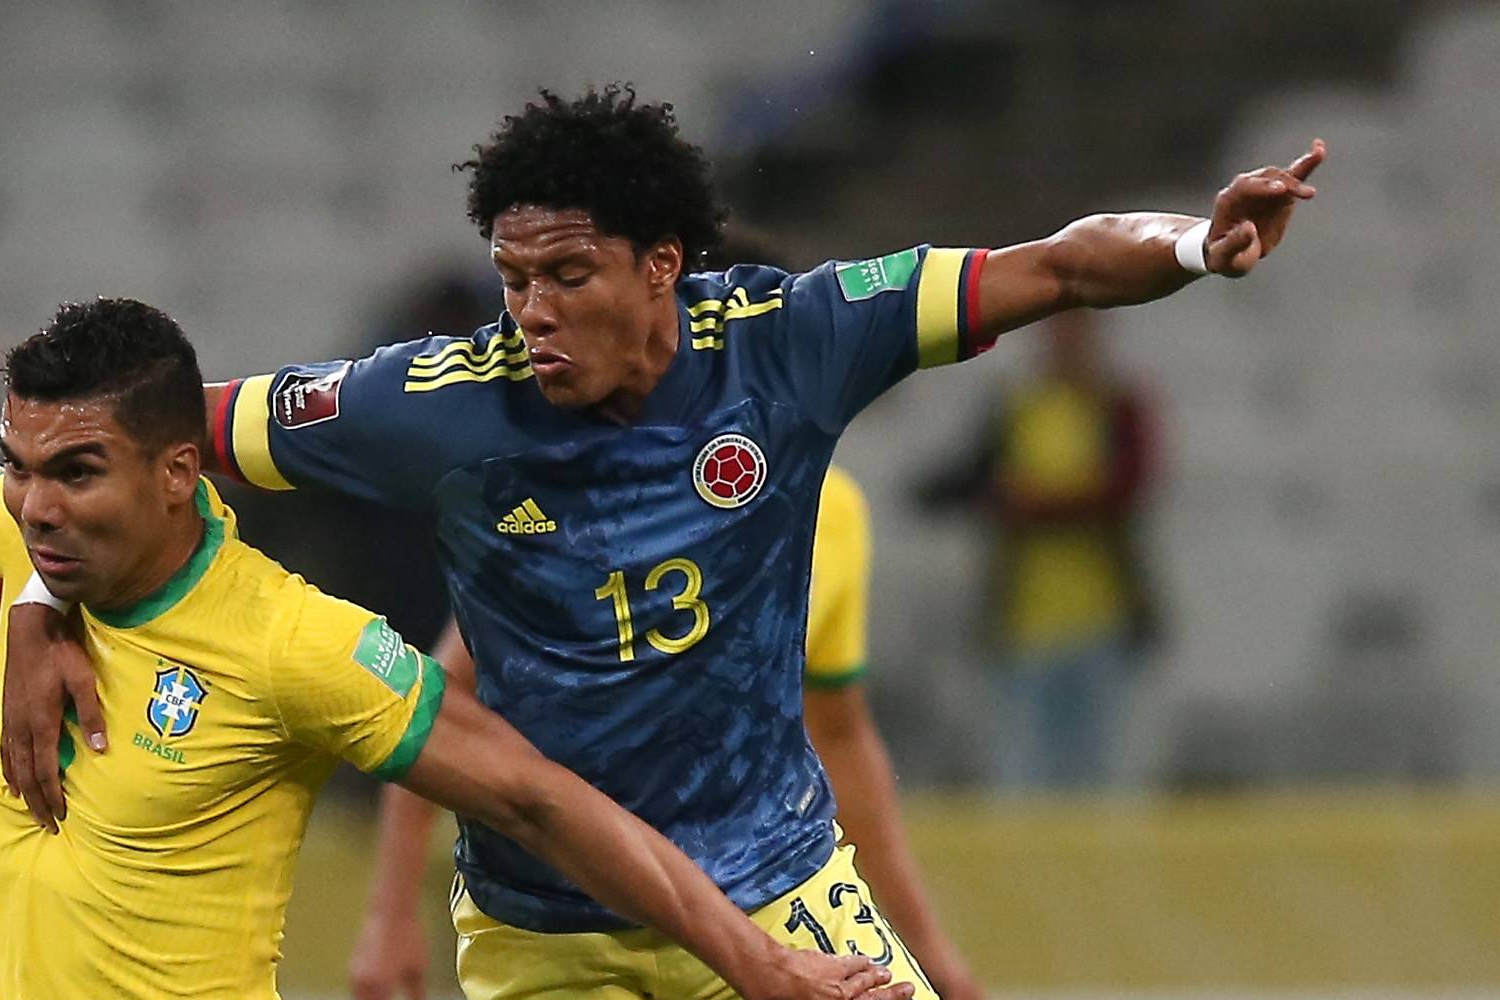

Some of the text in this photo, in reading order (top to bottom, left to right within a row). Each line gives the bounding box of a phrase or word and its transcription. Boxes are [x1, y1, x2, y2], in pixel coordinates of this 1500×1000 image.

[496, 520, 557, 534] adidas
[594, 557, 711, 662] 13
[165, 694, 186, 706] CBF
[133, 732, 186, 765] BRASIL
[784, 881, 894, 967] 13
